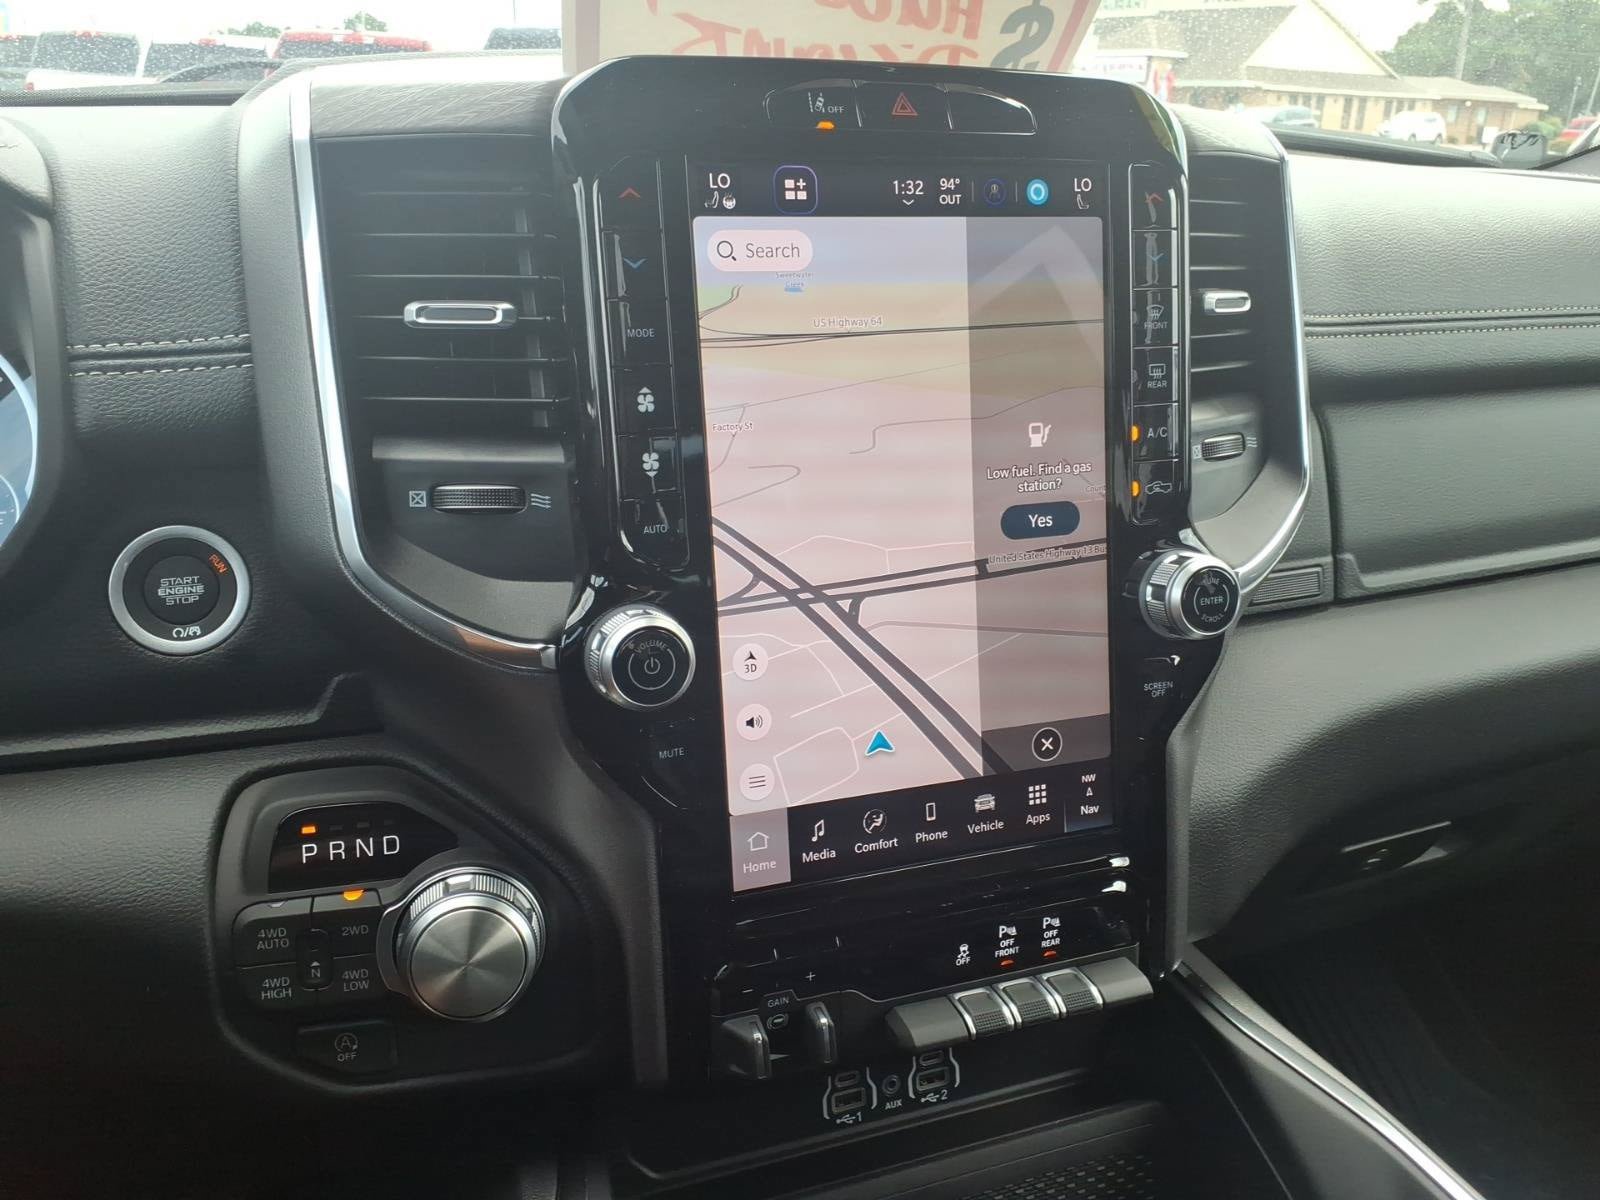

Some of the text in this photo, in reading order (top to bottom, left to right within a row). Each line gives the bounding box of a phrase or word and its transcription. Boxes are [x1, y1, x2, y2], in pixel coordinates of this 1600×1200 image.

[826, 104, 845, 114] OFF
[708, 172, 731, 189] LO
[939, 178, 961, 191] 94°
[1074, 178, 1093, 192] LO
[892, 180, 925, 196] 1:32
[939, 194, 962, 206] OUT
[745, 242, 801, 259] Search
[813, 316, 882, 328] US Highway 64
[1143, 321, 1168, 330] FRONT
[627, 328, 655, 338] MODE
[1147, 380, 1168, 389] REAR
[712, 421, 753, 433] Factory St
[1147, 426, 1168, 438] A/C
[987, 462, 1092, 480] Low fuel. Find a gas
[1018, 479, 1062, 493] station?
[1028, 514, 1053, 528] Yes
[643, 524, 668, 535] AUTO
[989, 553, 1017, 563] United
[1019, 551, 1043, 561] States
[1045, 548, 1080, 558] Highway
[208, 554, 228, 574] RUN
[160, 576, 200, 587] START
[158, 585, 205, 596] ENGINE
[166, 596, 200, 606] STOP
[1200, 596, 1224, 606] ENTER
[1201, 612, 1224, 624] SCROLL
[635, 639, 668, 654] VOLUME
[744, 662, 758, 674] 3D
[1143, 681, 1174, 692] SCREEN
[1151, 689, 1166, 698] OFF
[658, 747, 685, 759] MUTE
[1081, 773, 1097, 783] NW
[742, 802, 1100, 874] Home Media Comfort Phone Vehicle Apps Nav
[302, 835, 400, 864] P R N D
[257, 927, 287, 938] 4WD
[341, 925, 370, 936] 2WD
[1043, 929, 1060, 939] OFF
[256, 938, 290, 951] AUTO
[1000, 938, 1015, 948] OFF
[1041, 937, 1061, 948] REAR
[994, 946, 1020, 958] FRONT
[955, 956, 971, 967] OFF
[342, 968, 370, 980] 4WD
[261, 976, 291, 988] 4WD
[343, 979, 370, 992] LOW
[260, 987, 293, 1000] HIGH
[767, 996, 790, 1009] GAIN
[336, 1053, 357, 1062] OFF
[884, 1099, 903, 1110] AUX
